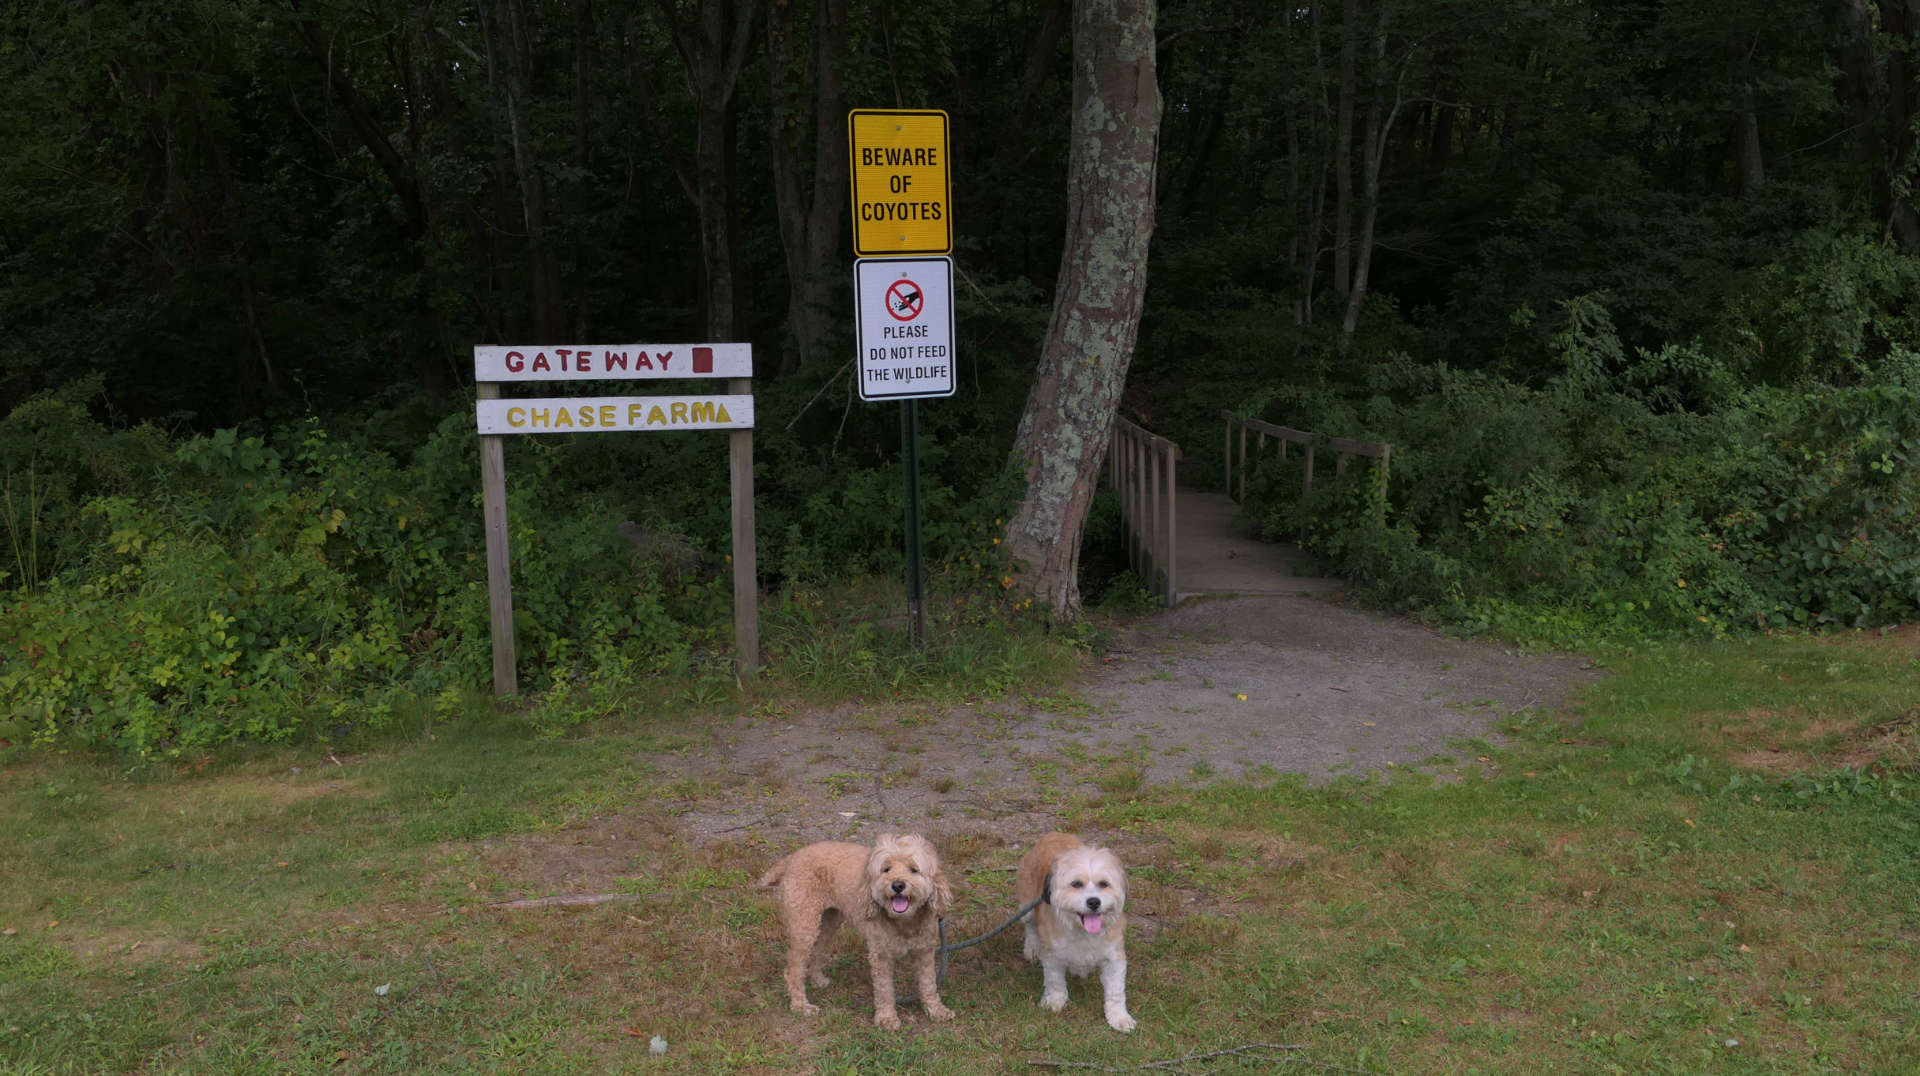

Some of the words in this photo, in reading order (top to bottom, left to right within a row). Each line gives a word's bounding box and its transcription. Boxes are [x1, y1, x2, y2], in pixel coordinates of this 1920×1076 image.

[862, 147, 937, 166] BEWARE
[889, 175, 912, 194] OF
[861, 201, 942, 222] COYOTES
[883, 325, 929, 340] PLEASE
[870, 348, 887, 361] DO
[890, 346, 914, 360] NOT
[918, 345, 946, 358] FEED
[866, 368, 890, 382] THE
[893, 365, 948, 381] WILDLIFE
[506, 405, 617, 428] CHASE
[627, 401, 715, 426] FARM
